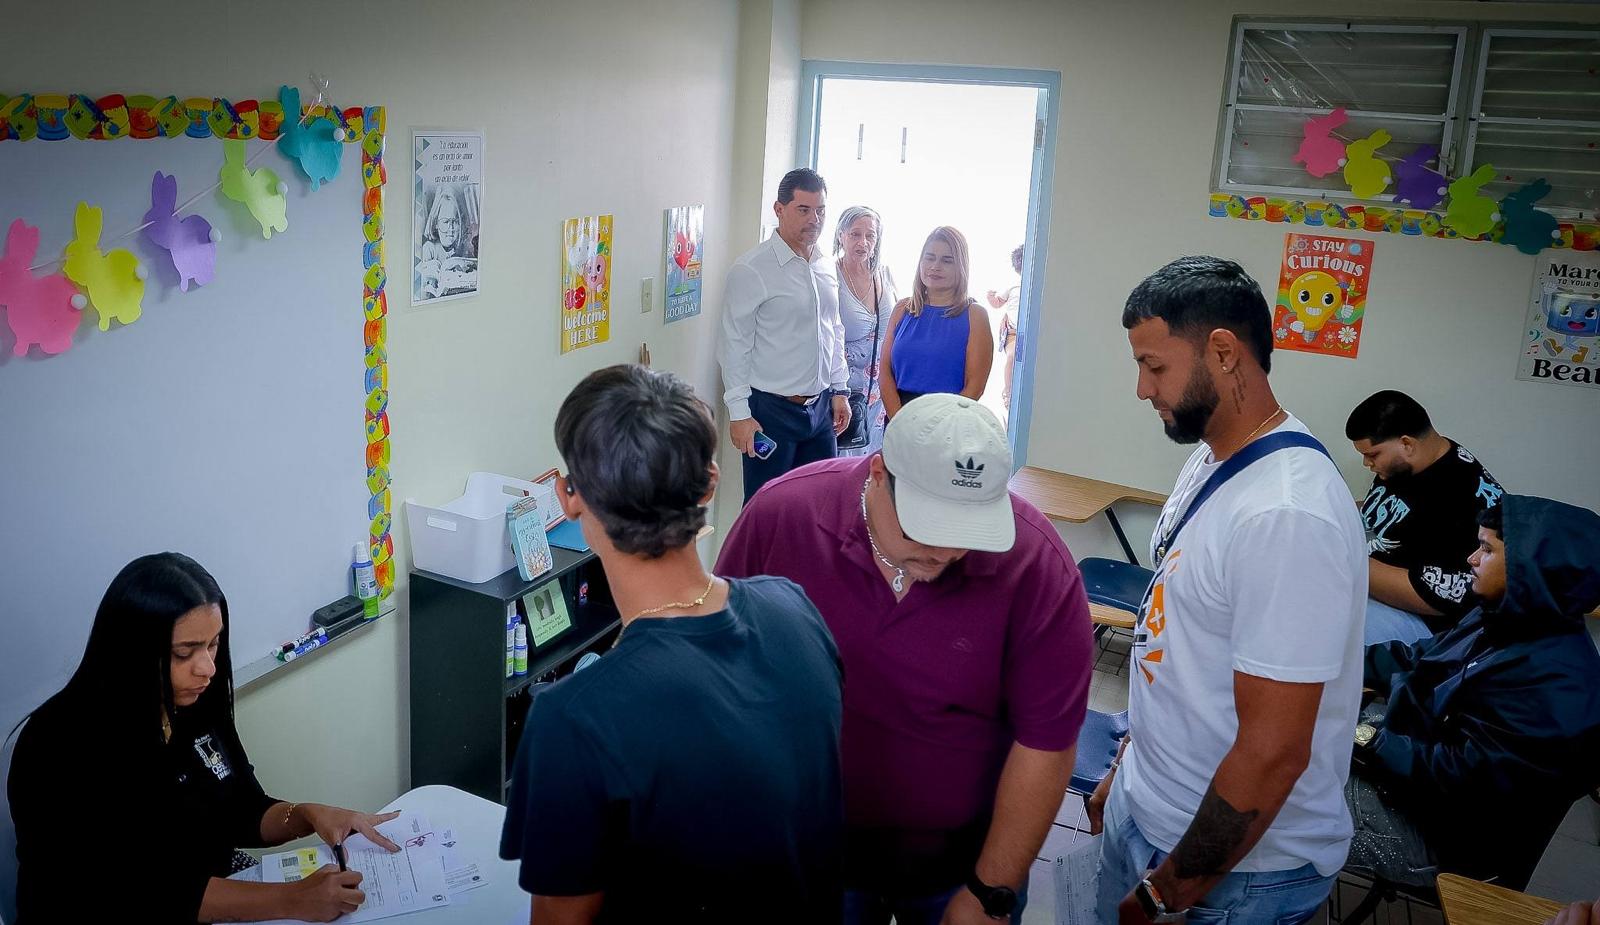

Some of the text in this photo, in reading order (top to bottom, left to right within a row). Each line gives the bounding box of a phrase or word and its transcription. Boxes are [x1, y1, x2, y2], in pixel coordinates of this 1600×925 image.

[1312, 240, 1345, 253] STAY
[1287, 254, 1365, 277] Curious
[1570, 279, 1591, 287] YOUR
[685, 302, 697, 314] DAY
[570, 325, 598, 346] HERE
[951, 479, 983, 489] adidas
